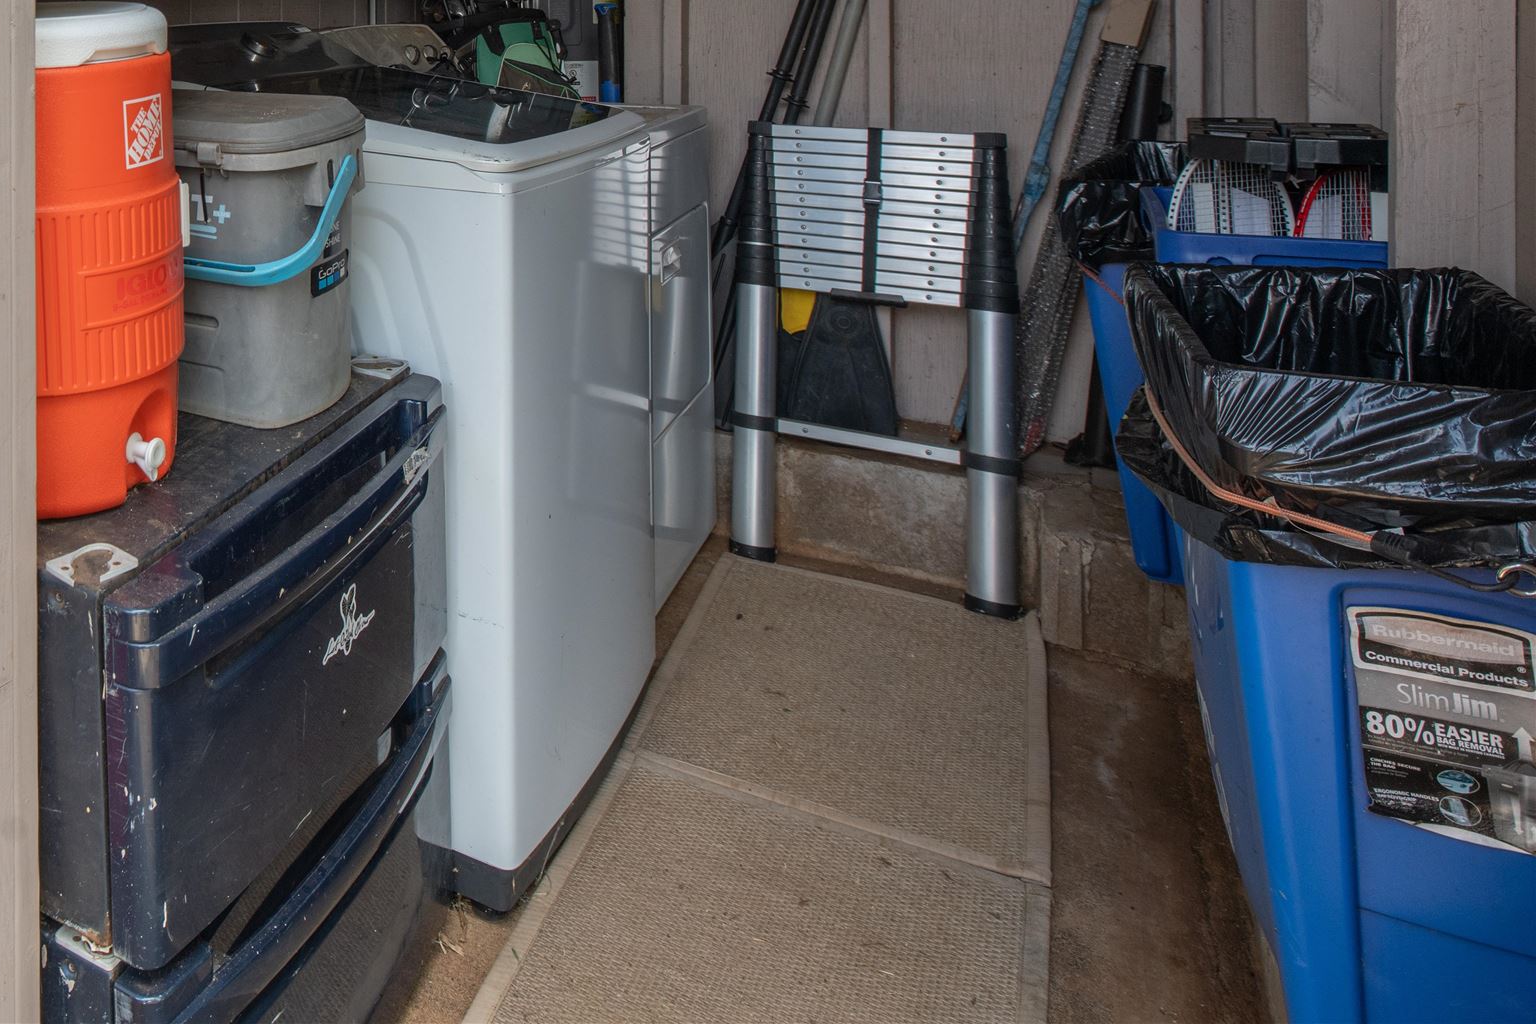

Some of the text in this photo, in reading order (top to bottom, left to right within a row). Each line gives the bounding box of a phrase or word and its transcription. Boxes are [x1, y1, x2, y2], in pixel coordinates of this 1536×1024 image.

[128, 97, 160, 164] HOME
[130, 107, 147, 134] THE
[143, 118, 161, 161] DEPOT
[318, 258, 345, 280] GoPro
[1371, 624, 1515, 657] Rubbermaid
[1365, 650, 1529, 687] Commercial Products
[1365, 711, 1436, 746] 80%
[1435, 723, 1504, 749] EASIER
[1436, 736, 1456, 746] BAG
[1458, 740, 1505, 755] REMOVAL
[1397, 762, 1421, 771] SECURE
[1373, 787, 1440, 802] ERGONOMIC HANDLES
